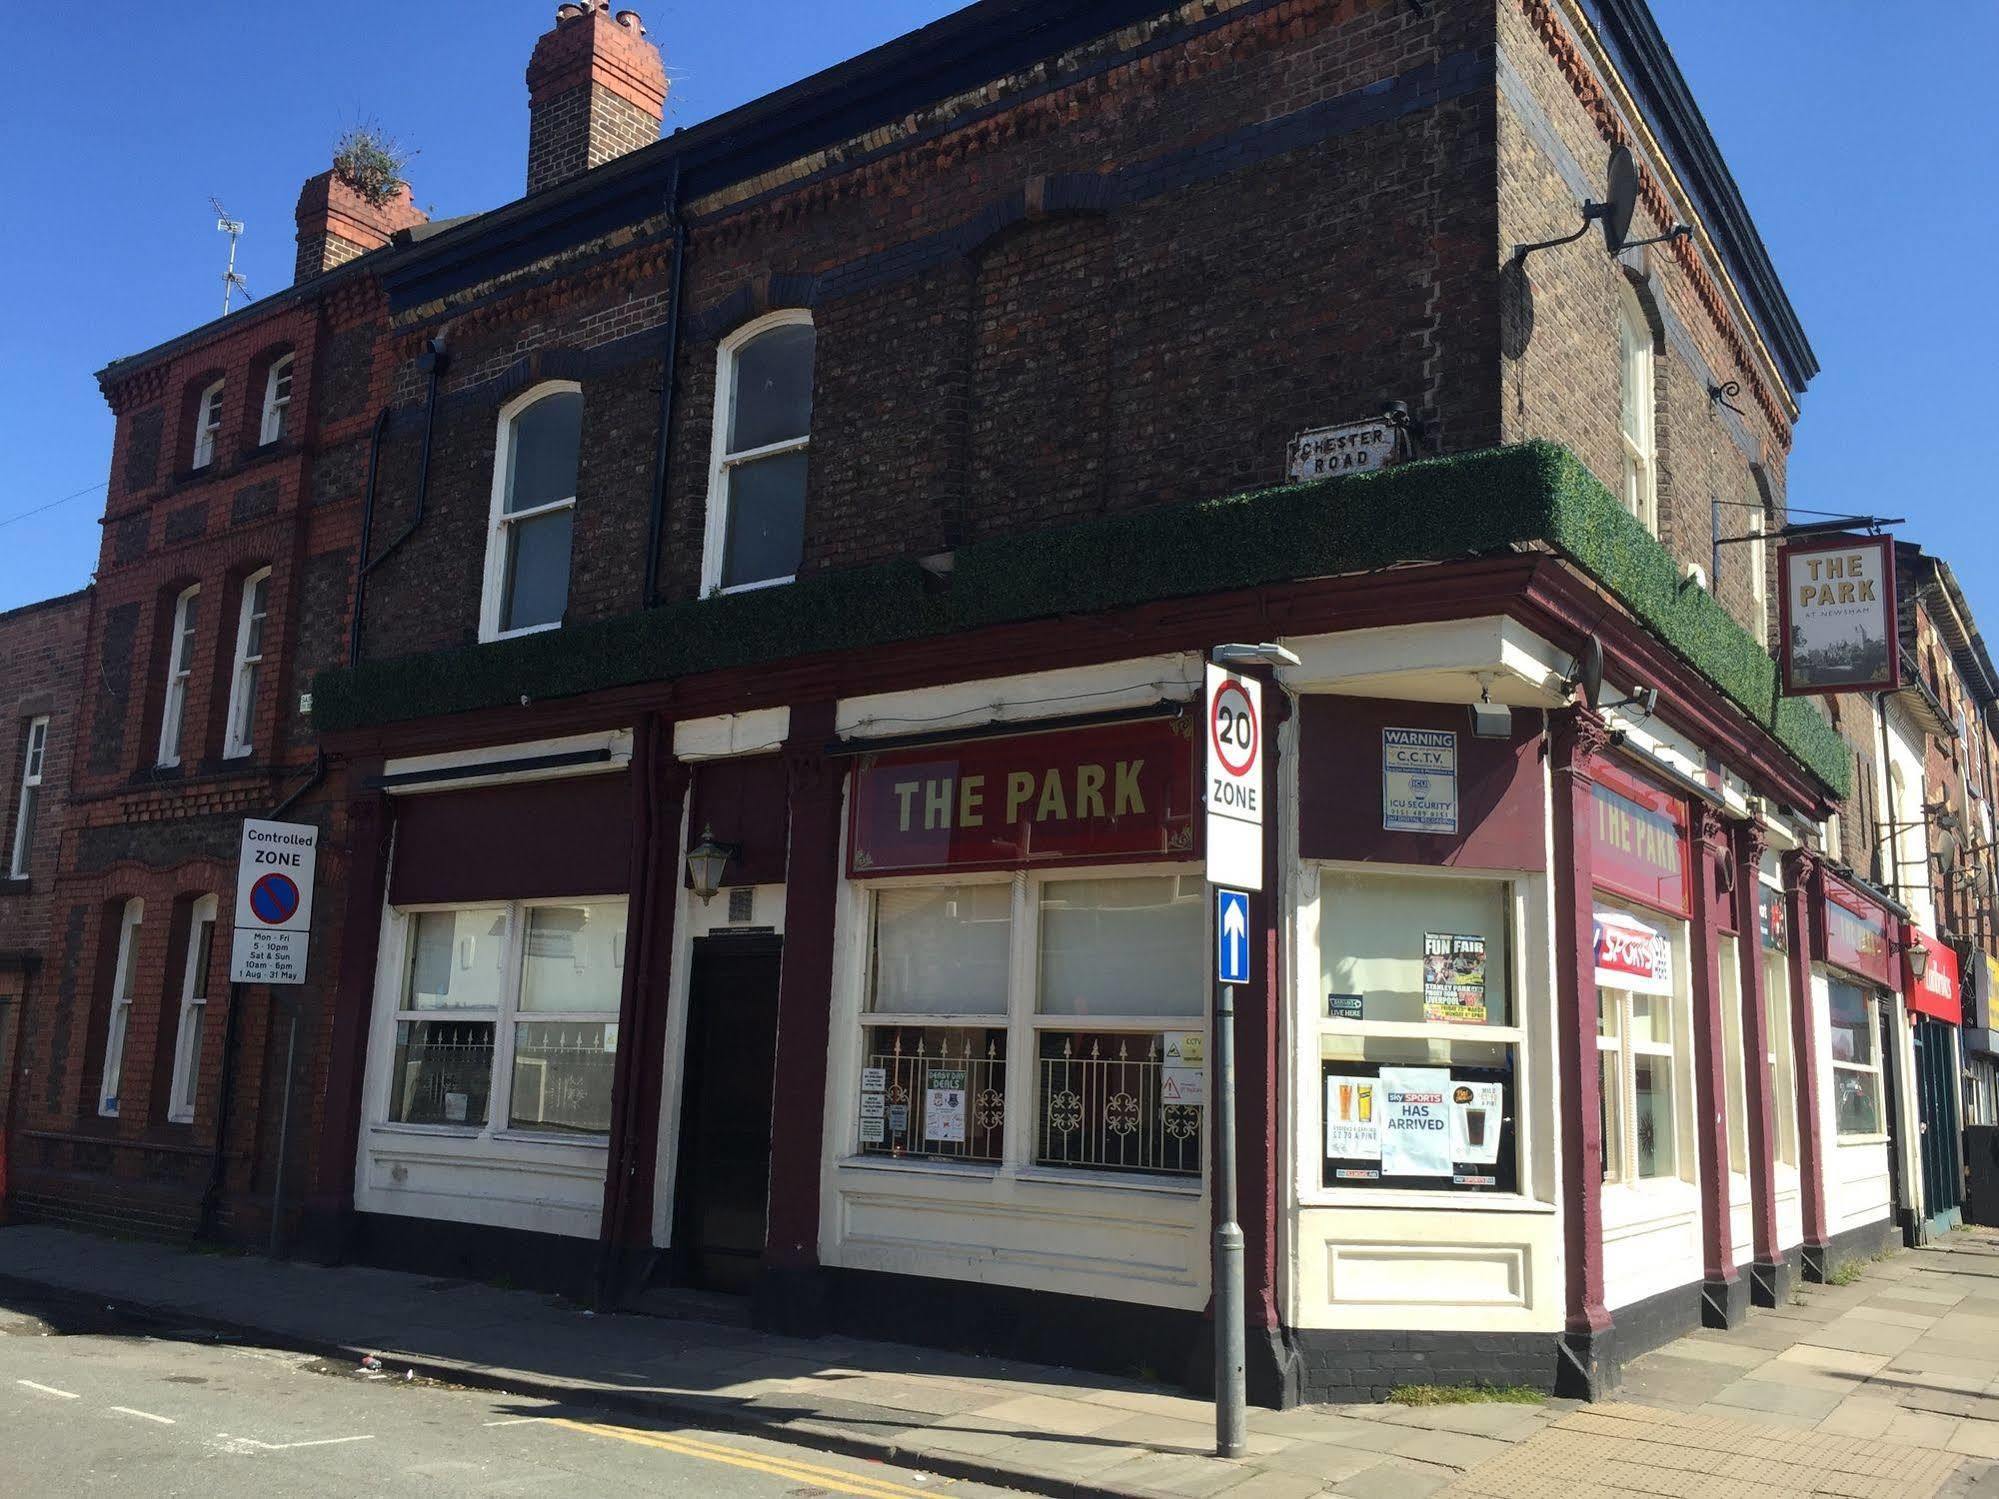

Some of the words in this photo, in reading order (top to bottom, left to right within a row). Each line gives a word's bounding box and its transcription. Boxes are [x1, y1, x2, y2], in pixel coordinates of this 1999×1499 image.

[1302, 430, 1382, 454] CHESTER
[1315, 451, 1367, 473] ROAD
[1807, 555, 1863, 581] THE
[1800, 580, 1875, 607] PARK
[1219, 706, 1250, 749] 20
[1386, 731, 1453, 746] WARNING
[1397, 751, 1443, 764] C.C.T.V.
[895, 775, 985, 832] THE
[1007, 760, 1146, 825] PARK
[1214, 779, 1257, 811] ZONE
[1390, 800, 1405, 808] ICU
[1408, 801, 1451, 811] SECURITY
[248, 830, 313, 847] Controlled
[1599, 799, 1631, 852] THE
[1636, 819, 1677, 873] PARK
[255, 850, 301, 867] ZONE
[254, 933, 272, 941] Mon
[280, 934, 290, 942] Fri
[267, 943, 289, 952] 10pm
[1425, 939, 1450, 955] FUN
[1454, 940, 1484, 953] FAIR
[1602, 928, 1653, 970] SPORTS
[250, 952, 264, 960] Sat
[275, 953, 290, 961] Sun
[245, 961, 267, 969] 10am
[275, 962, 293, 970] 6pm
[245, 970, 262, 979] Aug
[269, 971, 278, 979] 31
[281, 971, 297, 981] May
[1425, 996, 1459, 1005] LIVERPOOL
[933, 1080, 960, 1089] DEALS
[1405, 1094, 1442, 1103] SPORTS
[1402, 1105, 1429, 1116] HAS
[1388, 1119, 1444, 1130] ARRIVED
